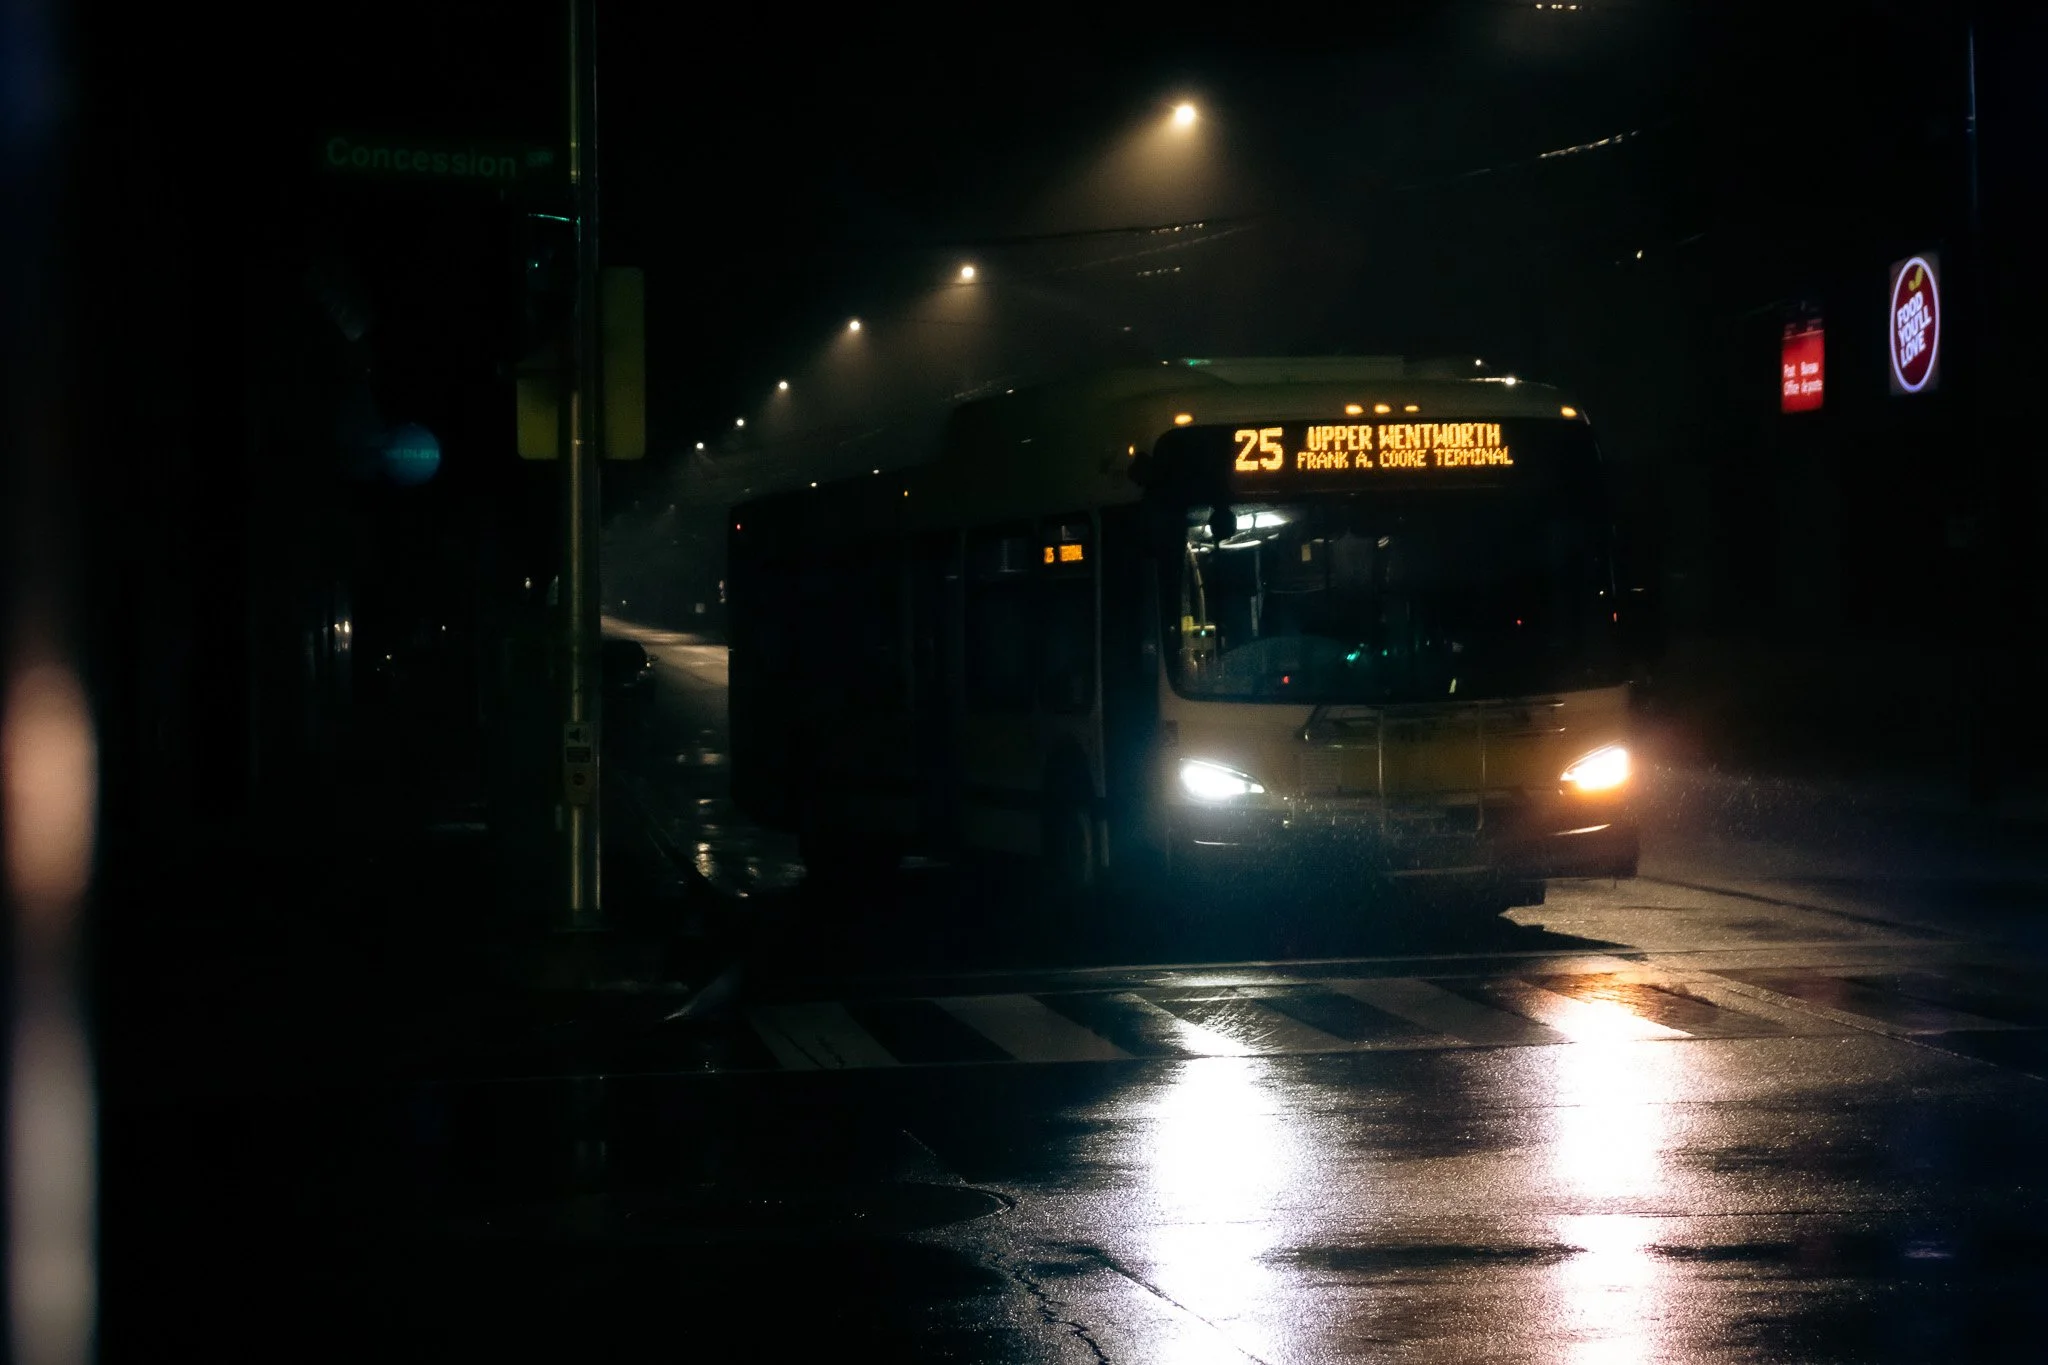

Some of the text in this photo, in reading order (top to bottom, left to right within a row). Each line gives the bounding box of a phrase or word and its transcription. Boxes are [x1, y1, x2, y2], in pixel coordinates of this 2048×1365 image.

[325, 137, 516, 178] Concession
[1897, 291, 1924, 329] FOOD
[1900, 330, 1926, 369] LOVE
[1234, 427, 1284, 471] 25
[1307, 423, 1501, 451] UPPER WENTWORTH
[1297, 446, 1513, 469] FRANK A. COOKE TERMINAL
